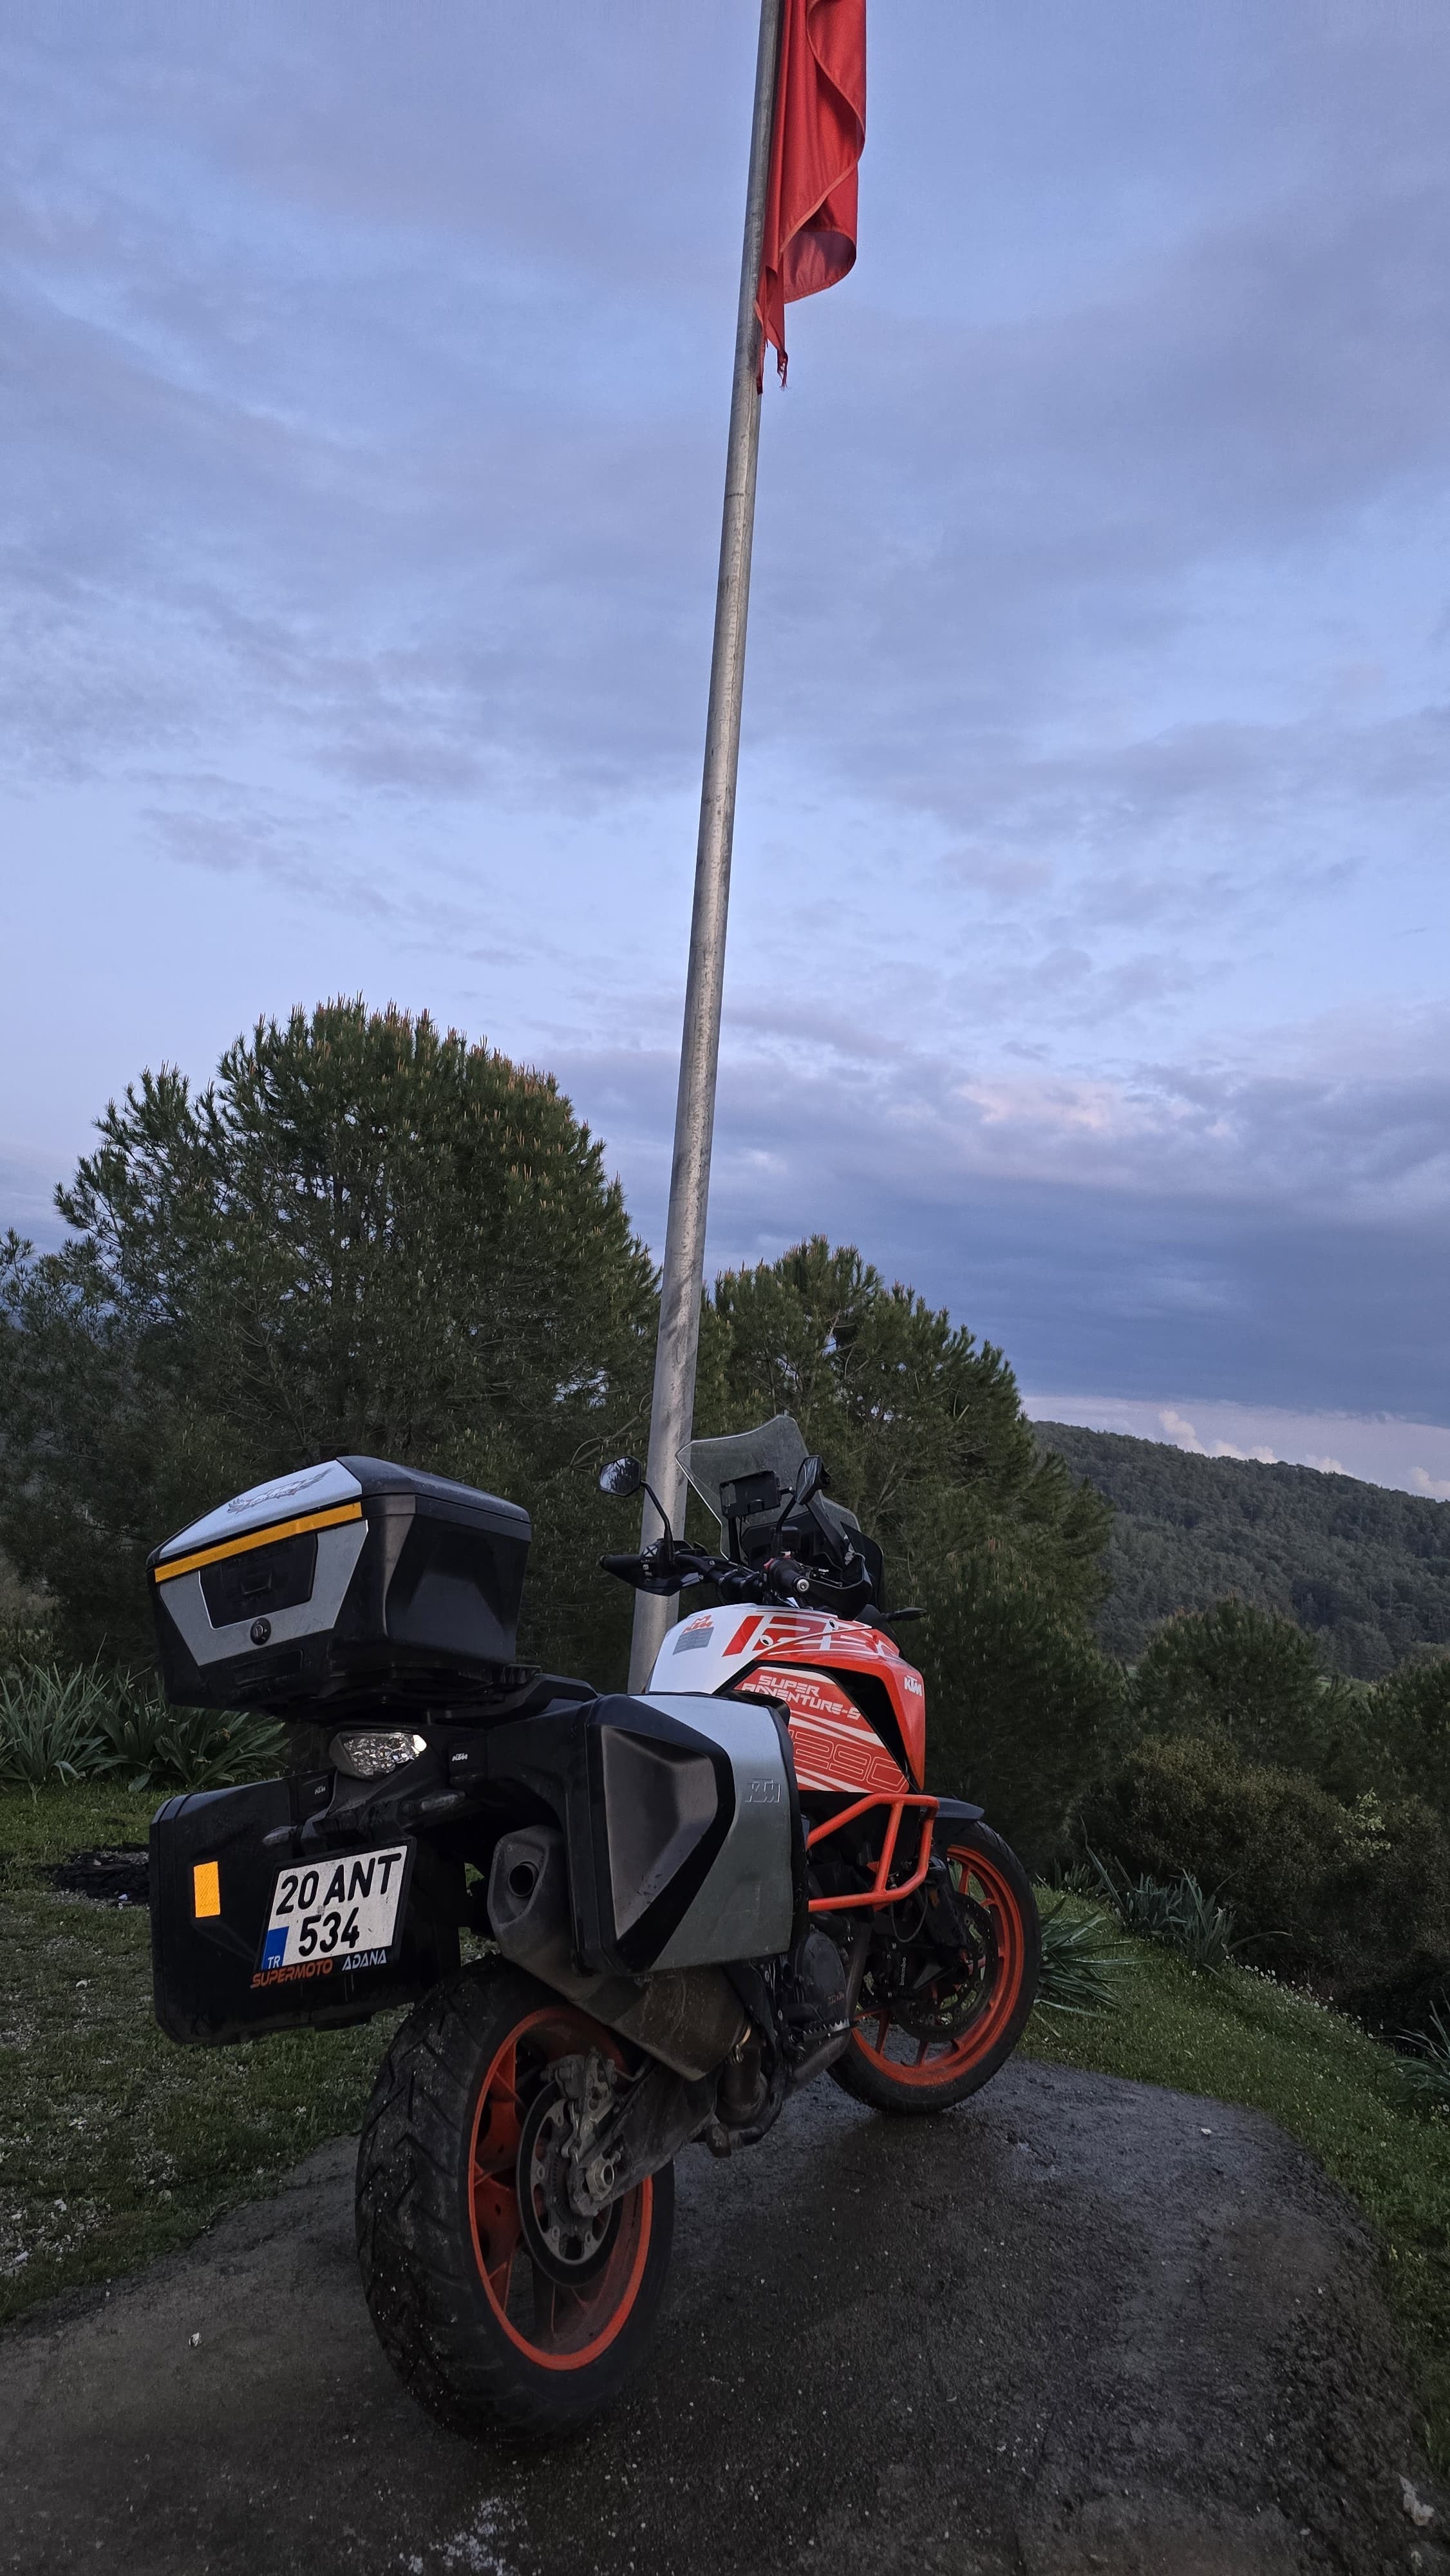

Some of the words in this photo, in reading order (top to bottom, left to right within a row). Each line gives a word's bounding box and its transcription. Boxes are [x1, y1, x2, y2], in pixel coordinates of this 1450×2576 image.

[758, 1675, 820, 1698] SUPER
[904, 1675, 923, 1697] KTM
[741, 1683, 862, 1721] ADVENTURE-S
[451, 1753, 468, 1761] KTM
[789, 1729, 907, 1794] 290
[745, 1778, 780, 1803] KTM
[276, 1870, 319, 1916] 20
[323, 1852, 402, 1906] ANT
[298, 1907, 360, 1957] 534
[250, 1958, 334, 1989] SUPERMOTO
[342, 1949, 388, 1971] ADANA
[267, 1955, 281, 1969] TR
